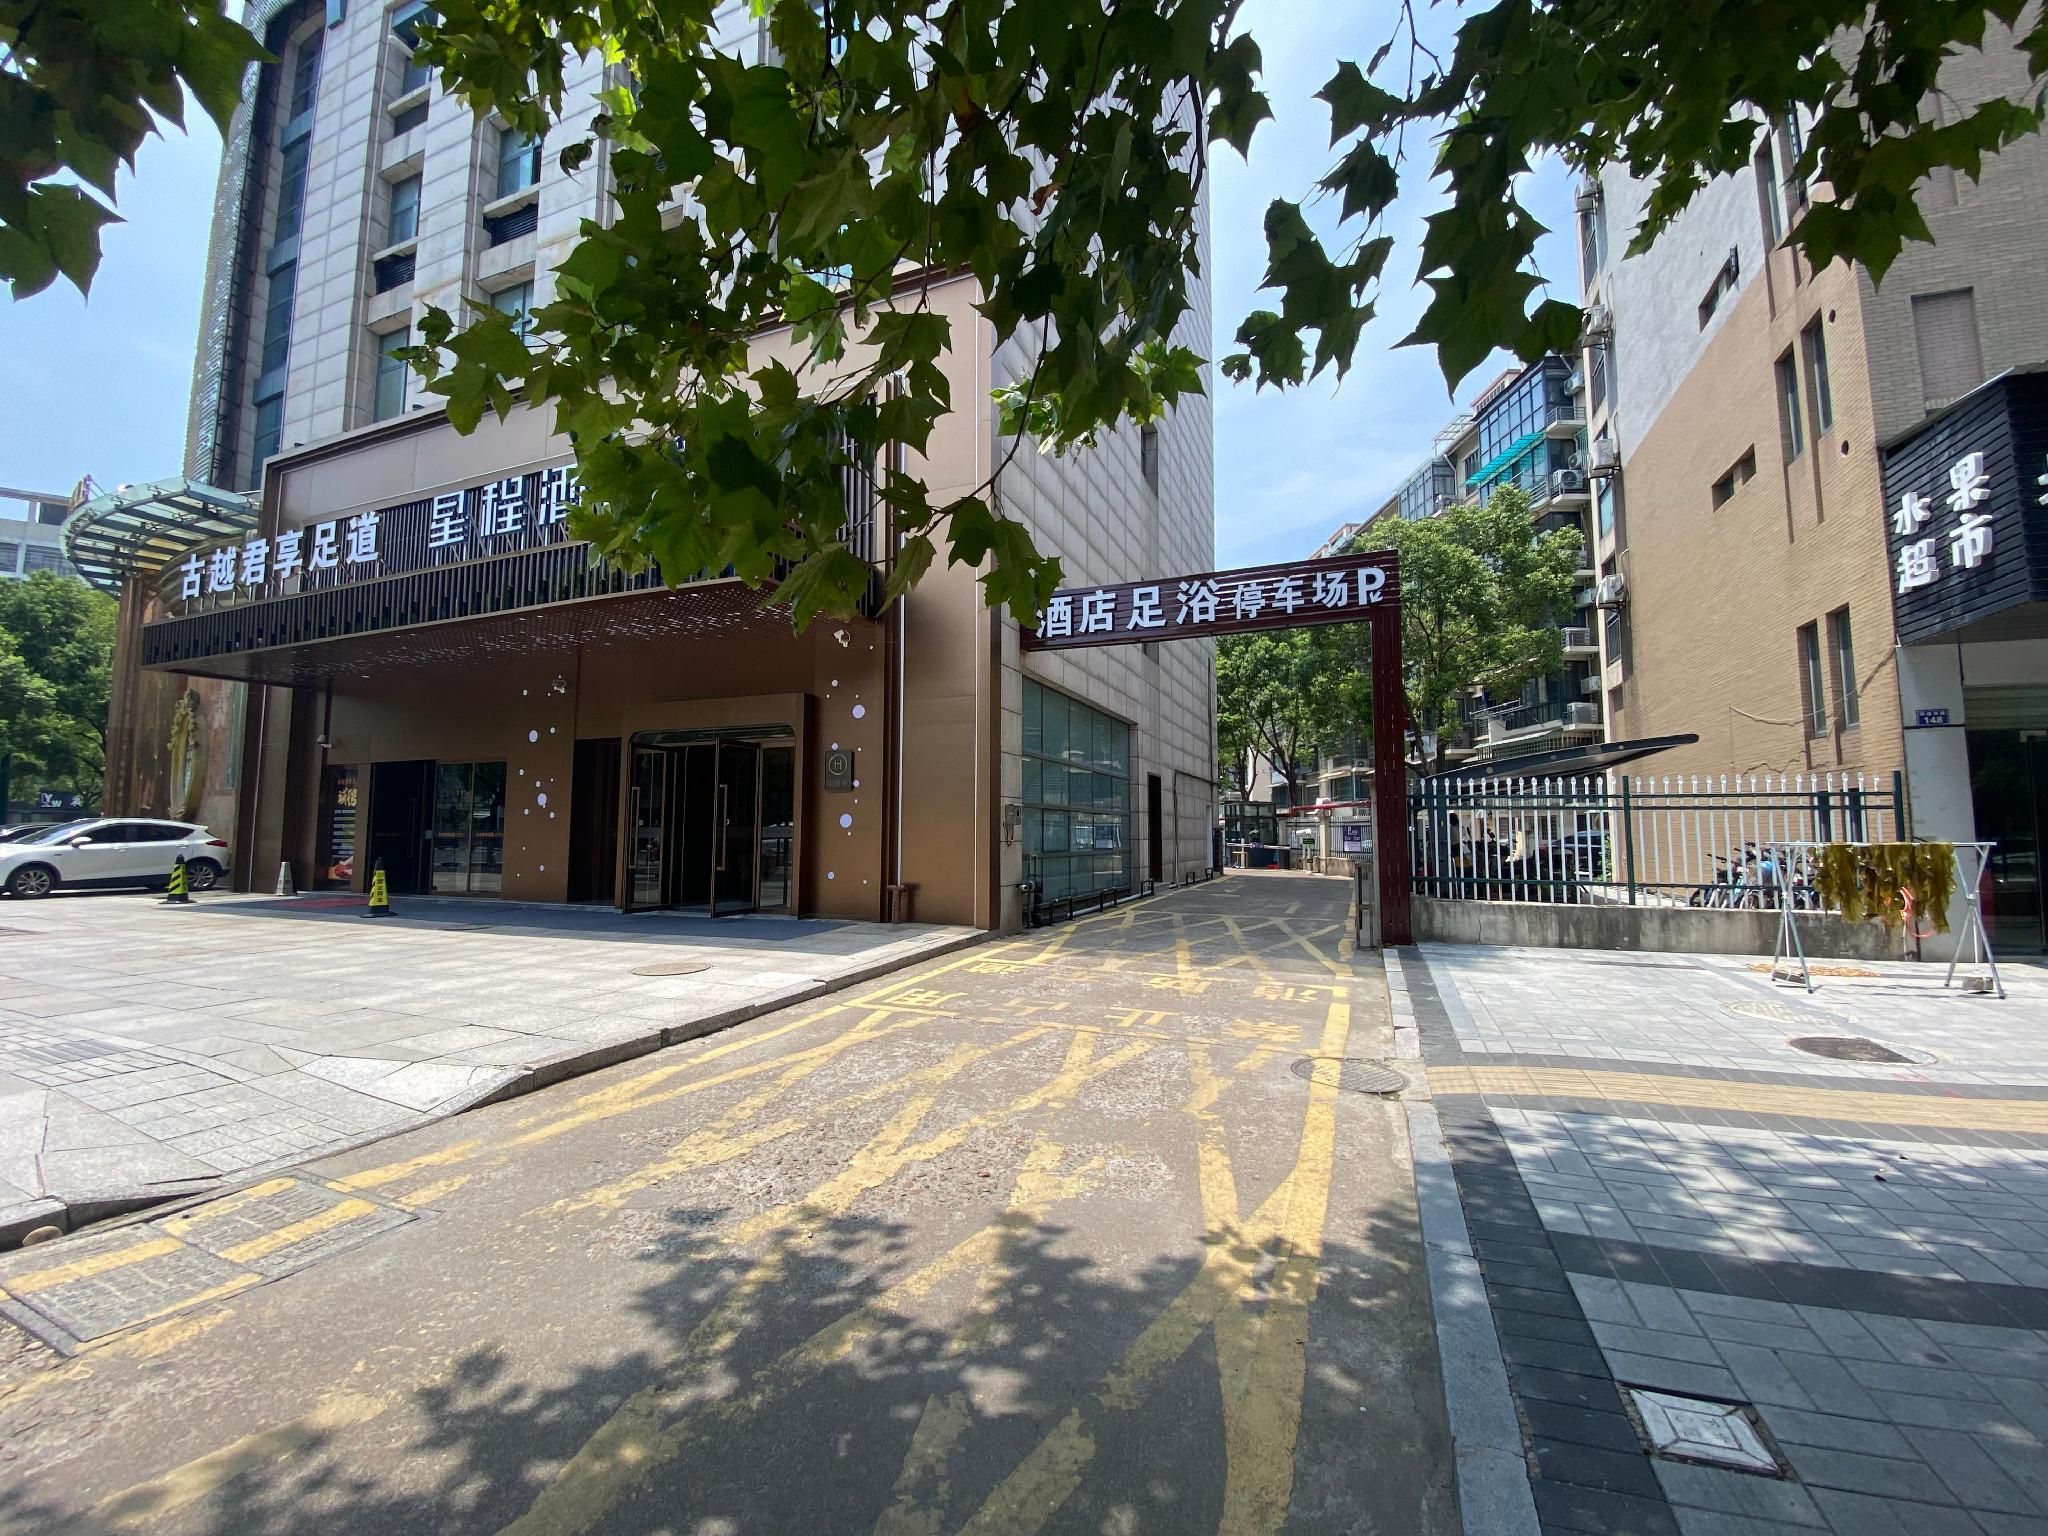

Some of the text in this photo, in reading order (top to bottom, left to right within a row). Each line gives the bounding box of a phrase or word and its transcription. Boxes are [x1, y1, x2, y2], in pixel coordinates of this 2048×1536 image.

[1893, 451, 1990, 537] 水果
[180, 510, 381, 602] 古越君享足道
[1897, 513, 1993, 594] 超市
[1923, 715, 1944, 724] 148
